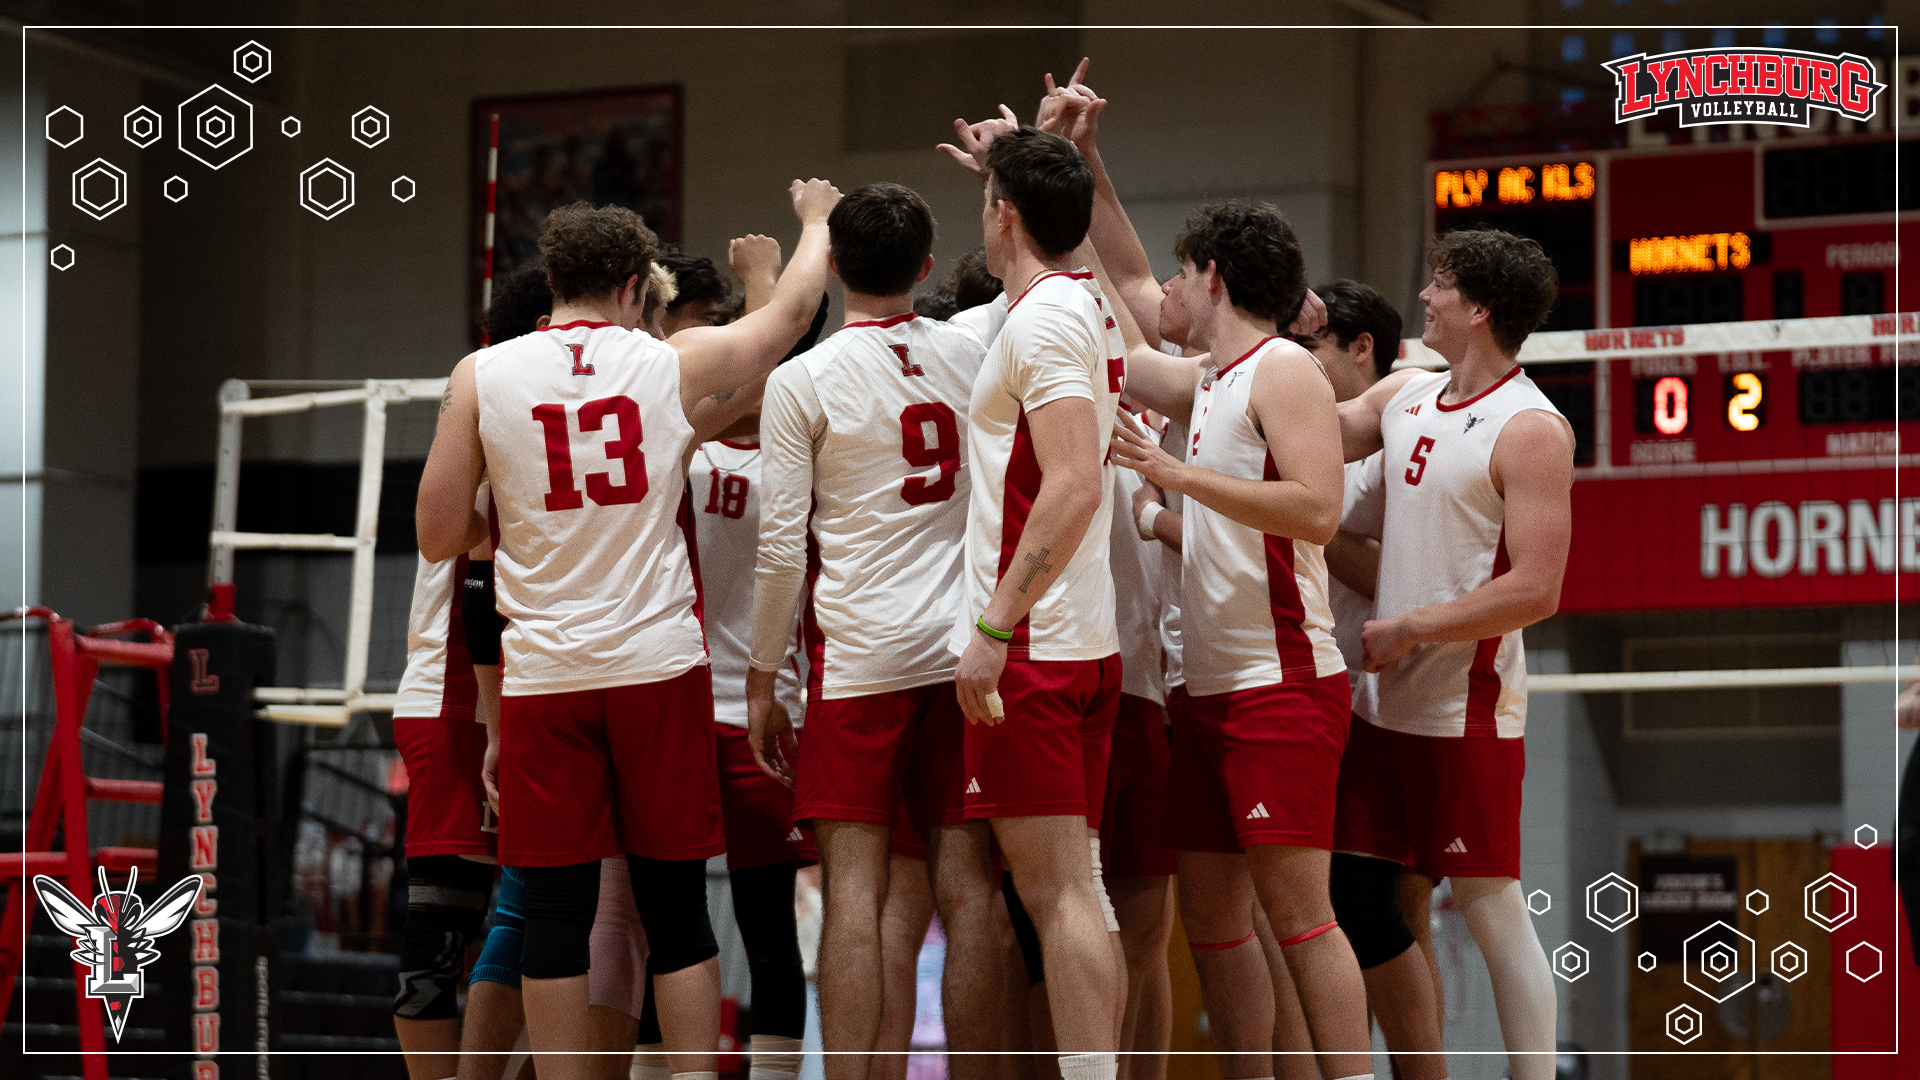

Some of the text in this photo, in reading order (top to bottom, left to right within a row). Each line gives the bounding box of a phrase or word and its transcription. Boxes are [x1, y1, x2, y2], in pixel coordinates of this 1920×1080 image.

[1630, 232, 1750, 275] HORNETS
[565, 344, 595, 376] L
[888, 343, 925, 376] L
[1585, 326, 1684, 352] HORNETS
[1654, 377, 1688, 434] 0
[1728, 373, 1762, 431] 2
[531, 395, 649, 512] 13
[900, 402, 961, 506] 9
[1405, 436, 1435, 486] 5
[704, 468, 749, 519] 18
[188, 649, 220, 695] L
